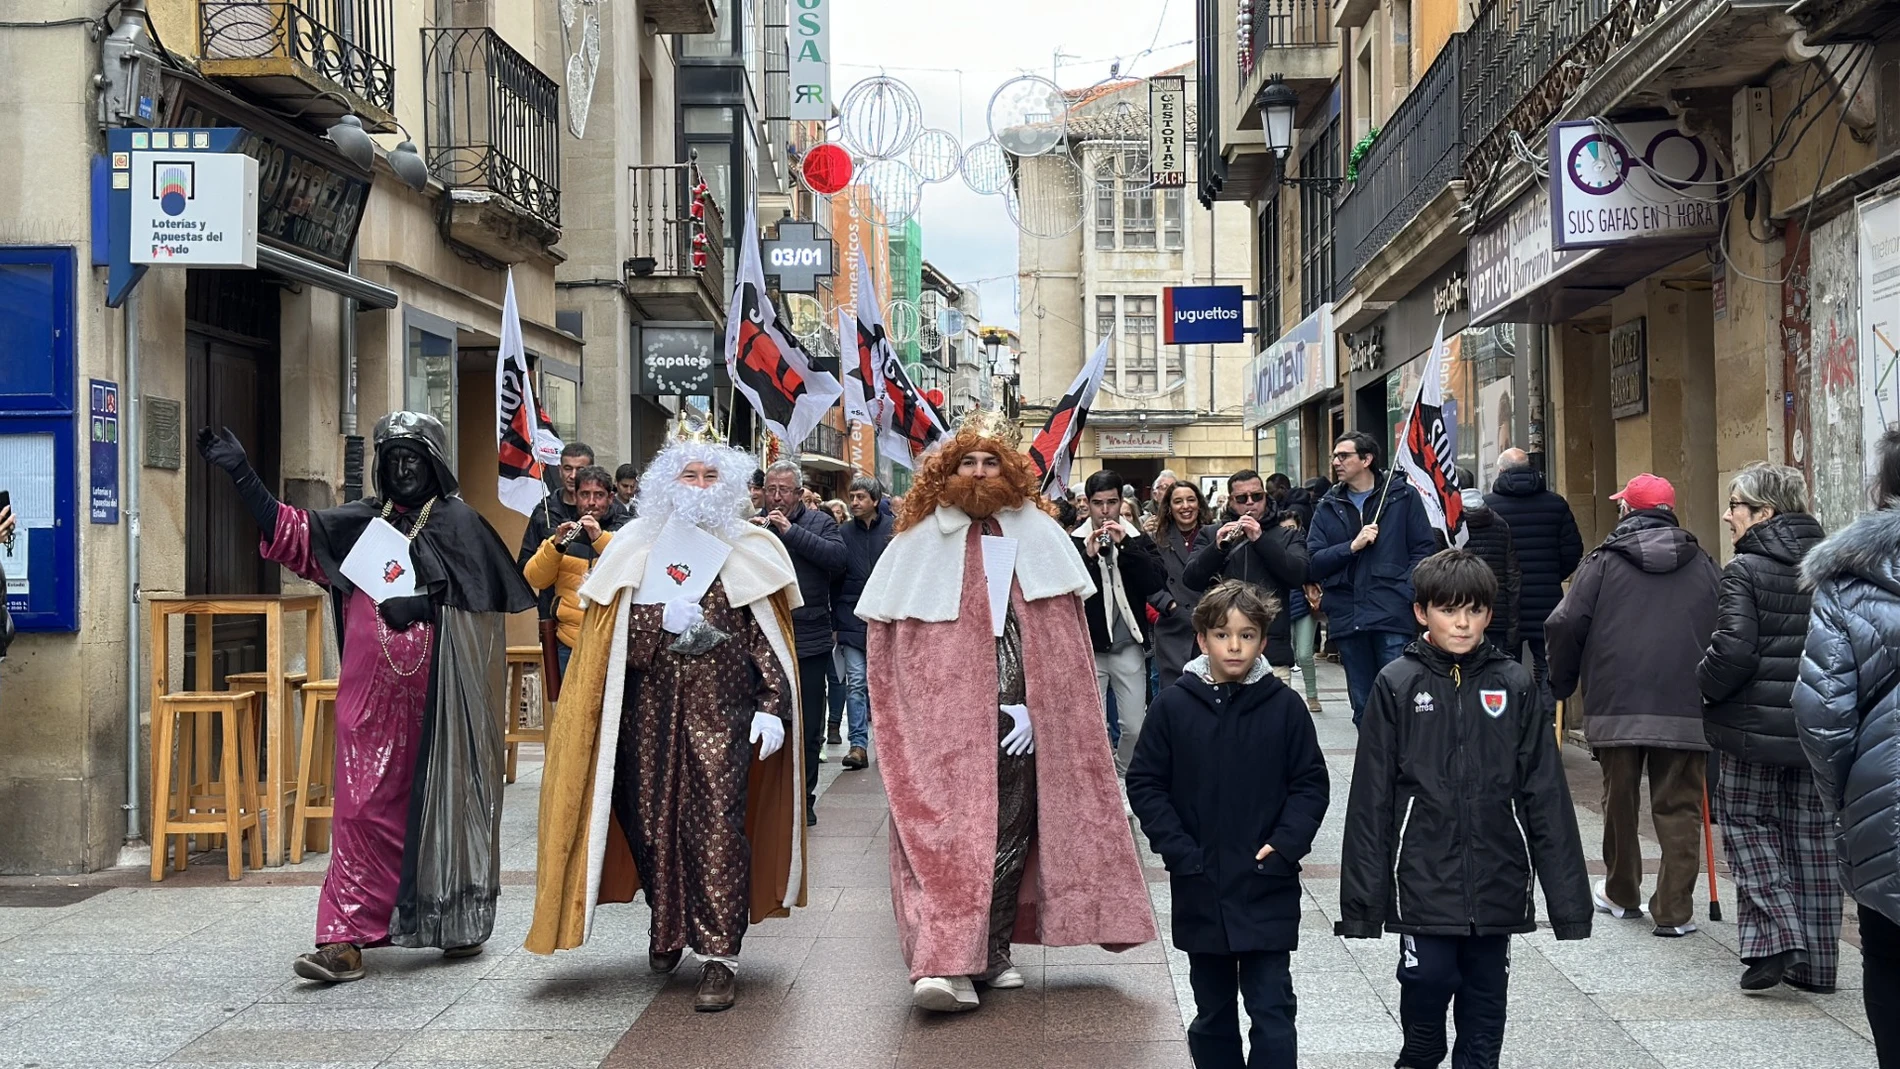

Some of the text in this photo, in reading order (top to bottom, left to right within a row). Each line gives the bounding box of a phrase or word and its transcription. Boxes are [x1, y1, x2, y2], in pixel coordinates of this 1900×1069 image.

[1160, 94, 1175, 170] GESTORIAS
[1153, 172, 1184, 185] FOLCH
[152, 218, 206, 231] Loterías y
[1568, 203, 1714, 235] SUS GAFAS EN 1 HORA
[152, 231, 223, 243] Apuestas del
[1472, 222, 1509, 272] CENTRO
[1872, 235, 1900, 261] metro
[771, 248, 821, 266] 03/01
[1472, 256, 1510, 312] OPTICO
[1174, 306, 1238, 323] juguettos
[1255, 340, 1305, 407] VITALDENT
[1105, 434, 1163, 446] Wonderland
